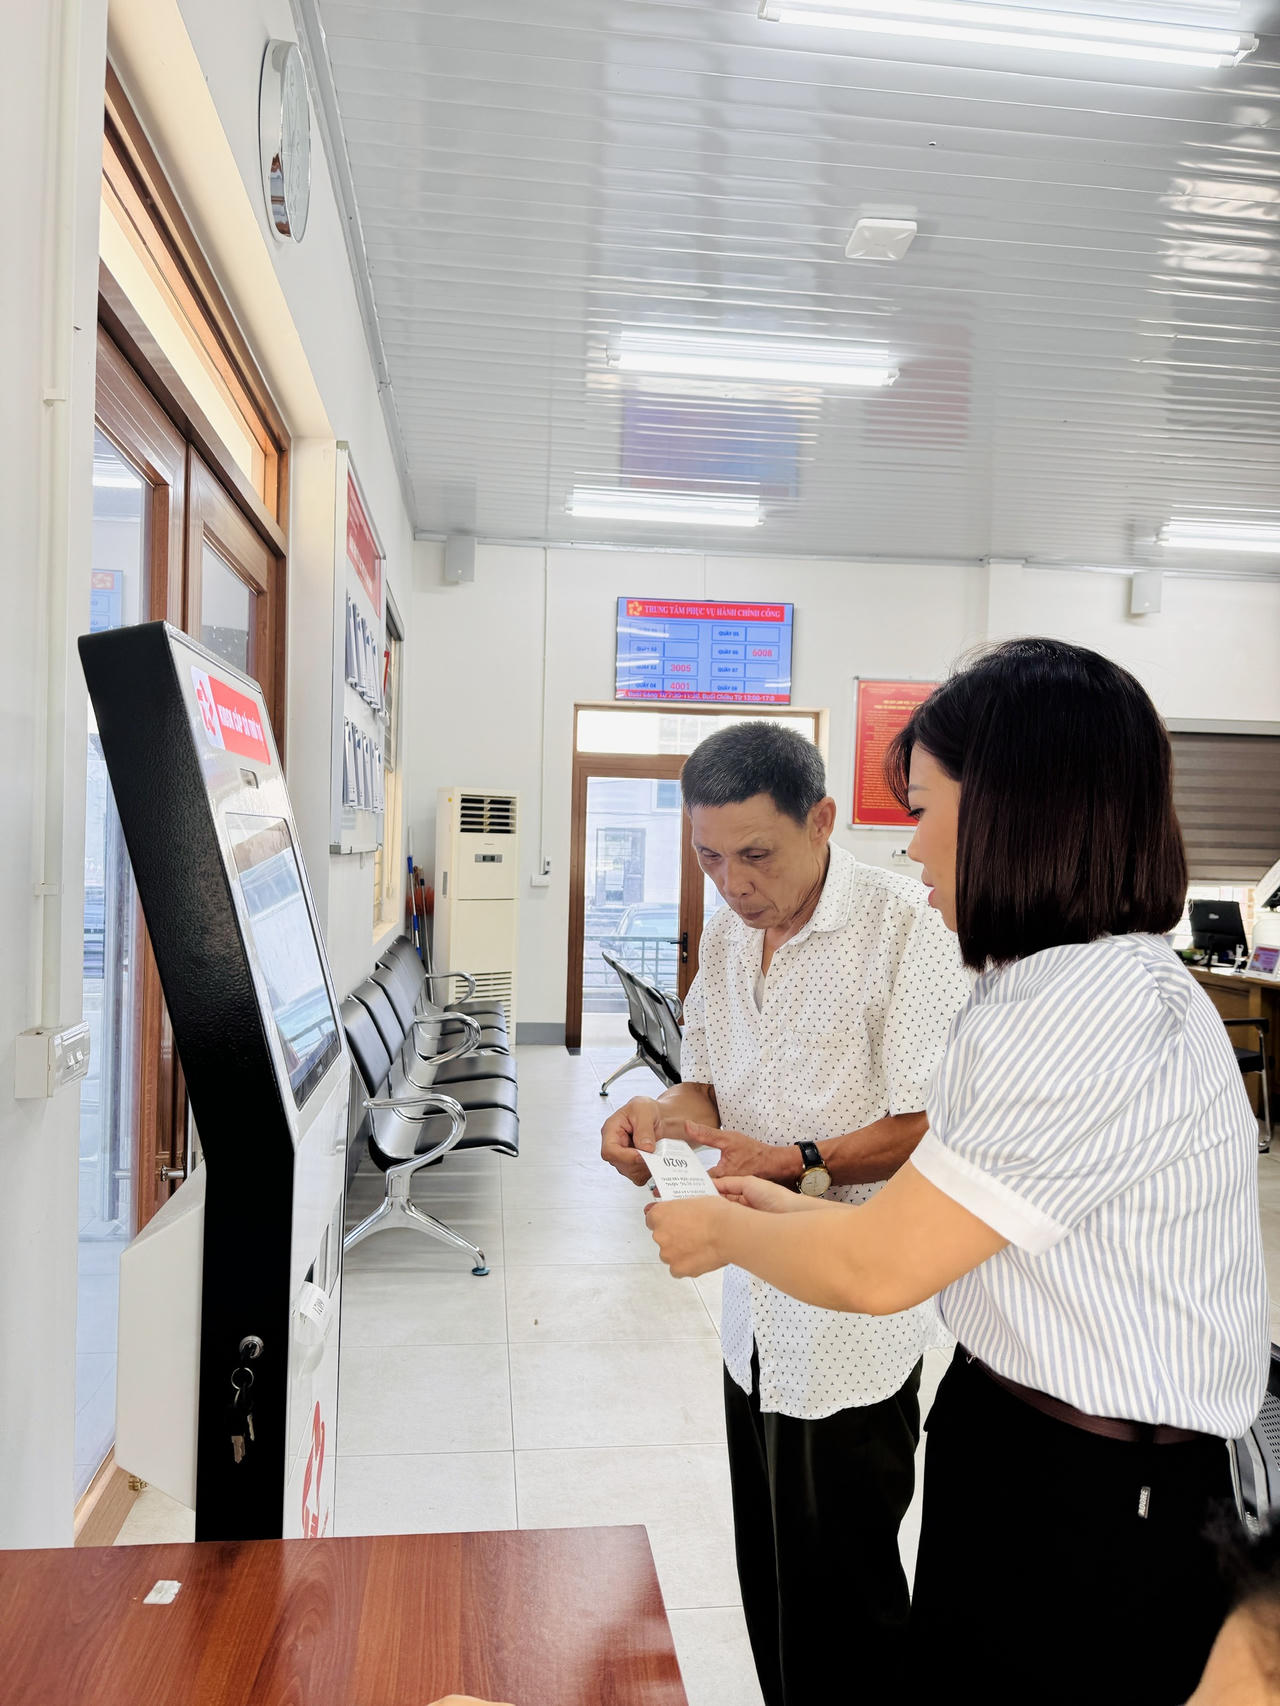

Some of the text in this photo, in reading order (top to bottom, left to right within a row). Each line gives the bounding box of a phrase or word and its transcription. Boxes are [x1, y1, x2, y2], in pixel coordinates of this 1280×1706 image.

[644, 603, 781, 618] TRUNG TÂM PHỤC VỤ HÀNH CHÍNH CÔNG
[752, 648, 773, 657] 6008
[670, 663, 692, 672] 3005
[670, 681, 691, 690] 4001
[663, 1157, 688, 1168] 6020
